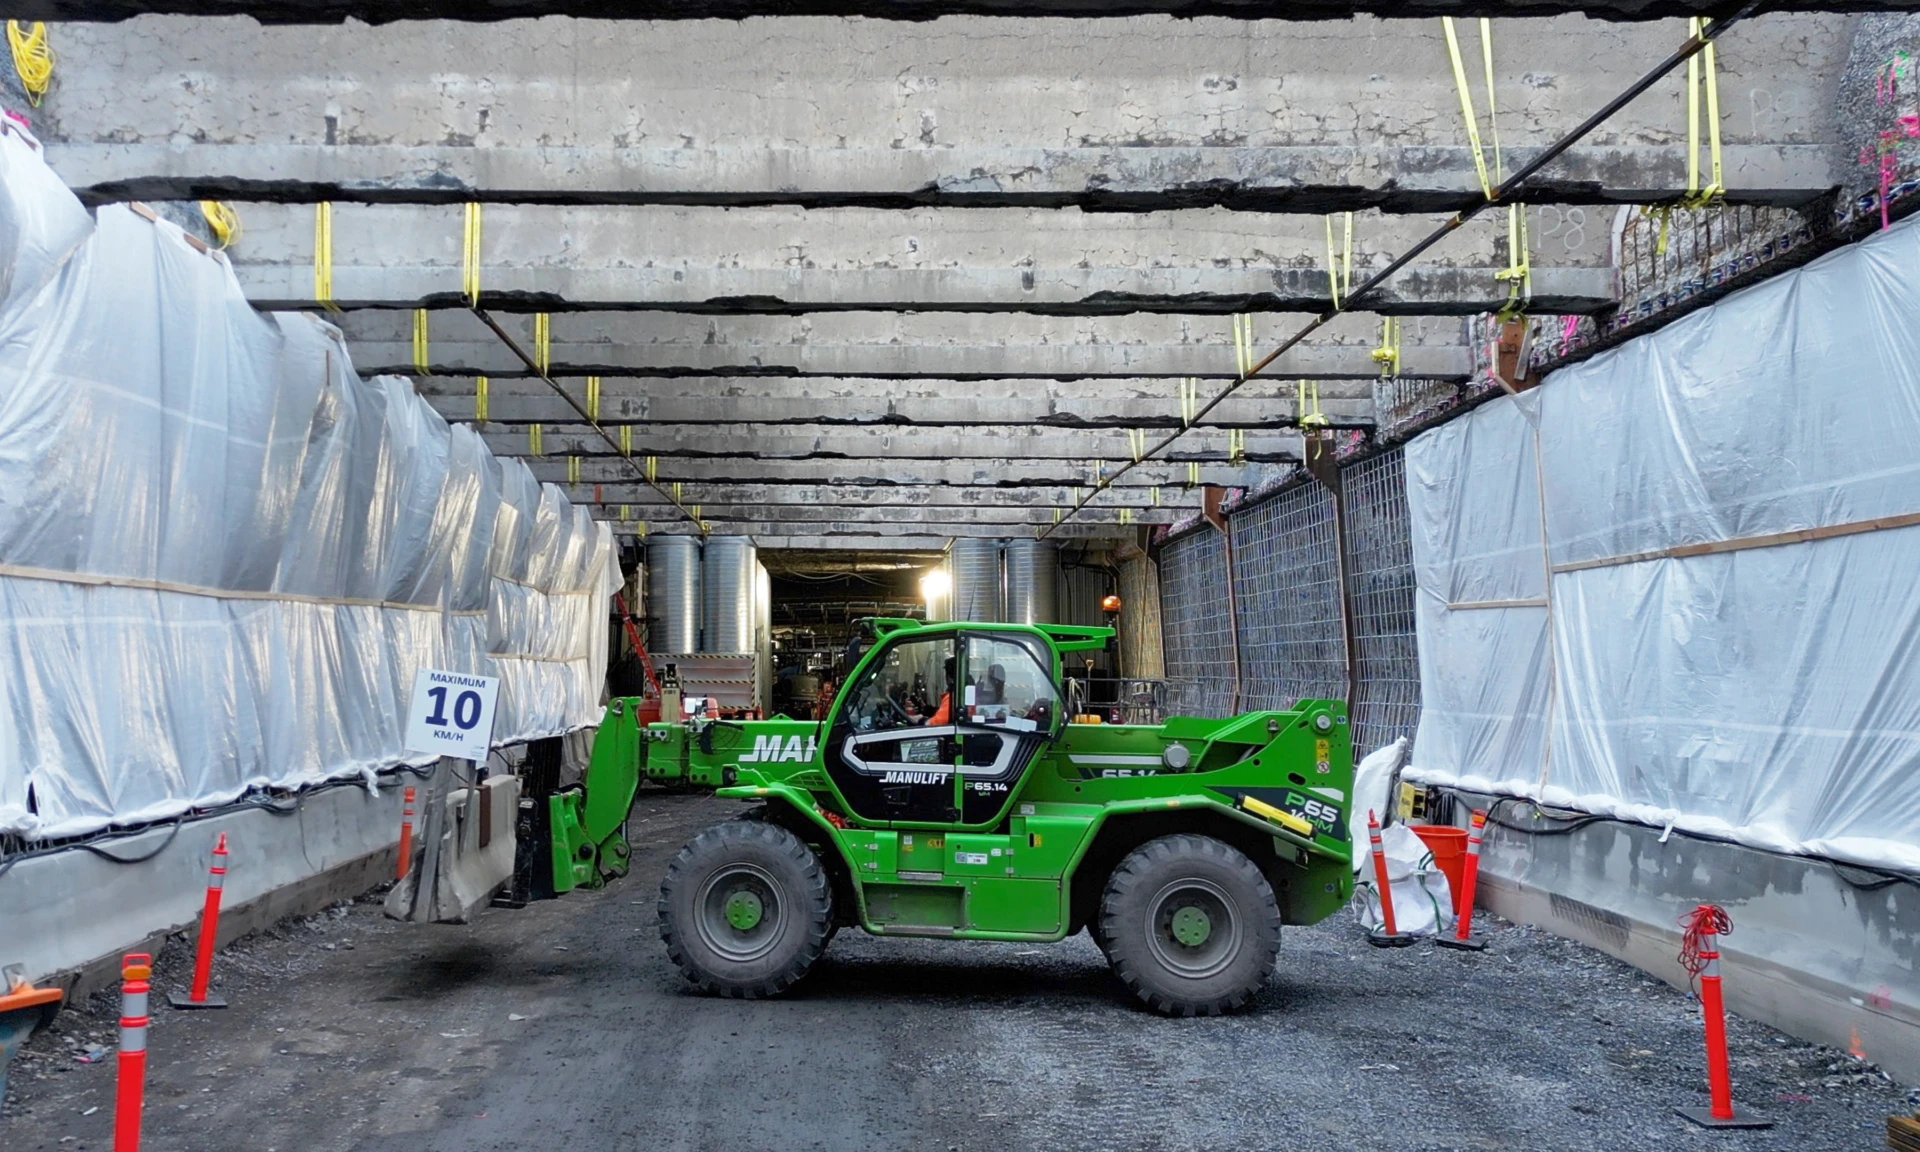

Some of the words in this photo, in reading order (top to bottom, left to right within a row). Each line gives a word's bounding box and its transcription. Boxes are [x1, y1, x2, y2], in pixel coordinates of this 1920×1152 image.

[1537, 205, 1586, 250] P8
[430, 673, 486, 688] MAXIMUM
[425, 686, 482, 730] 10
[433, 730, 464, 742] KM/H
[879, 771, 948, 785] MANULIFT
[964, 782, 1008, 791] P65.14
[1285, 791, 1338, 823] P65
